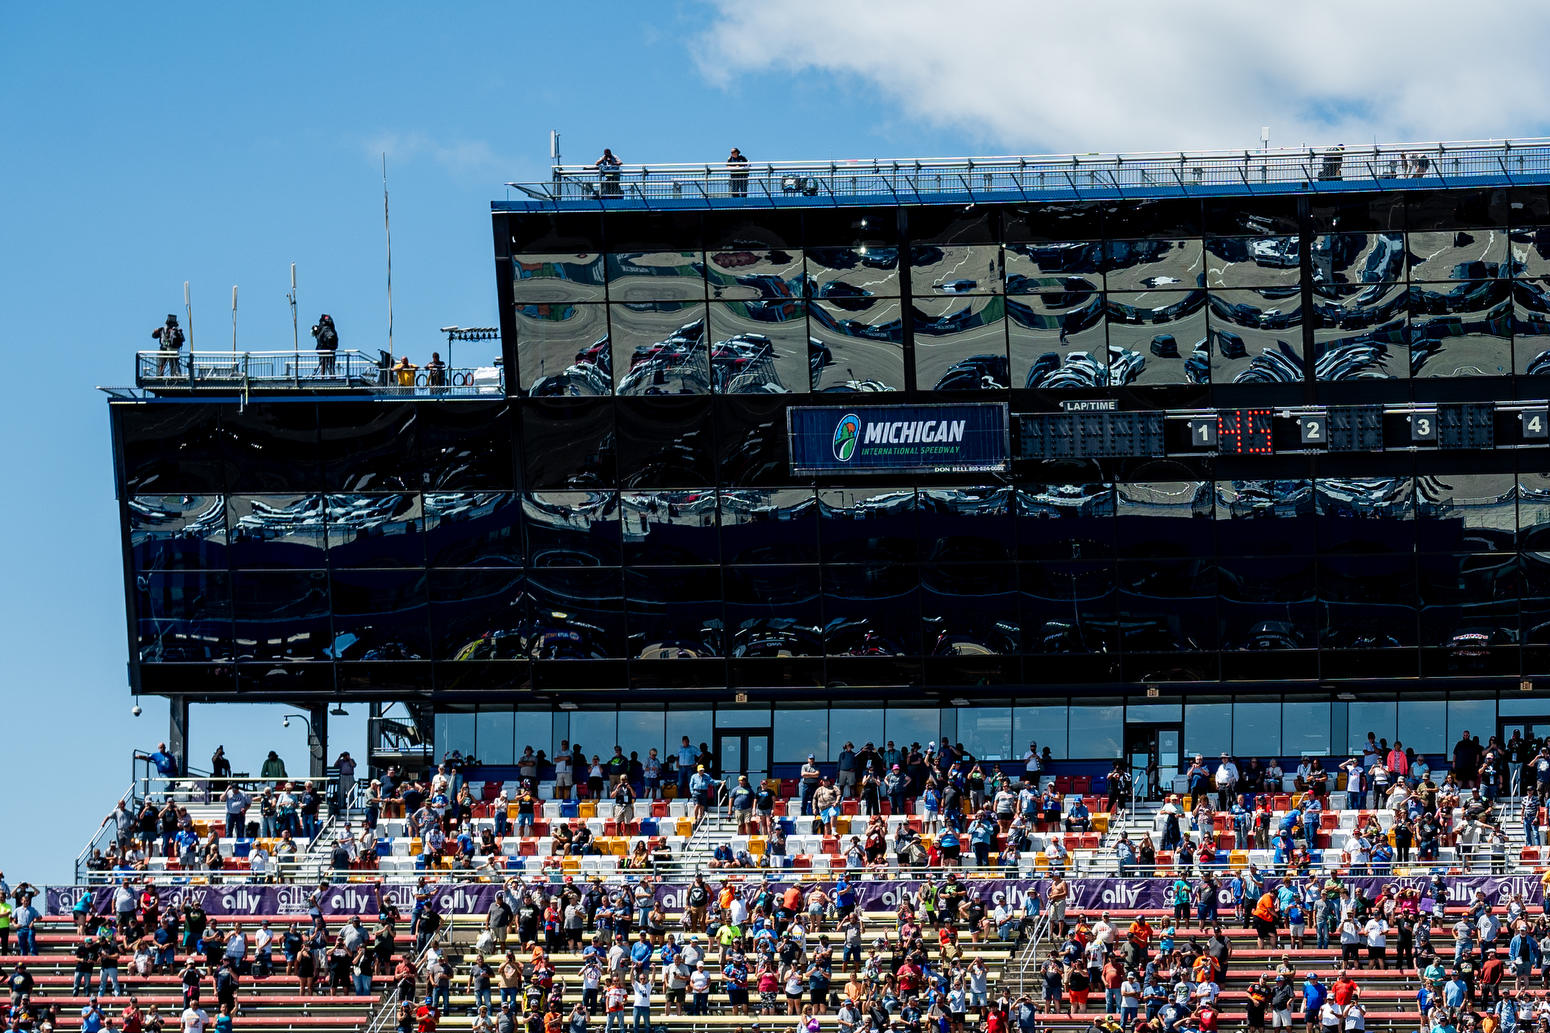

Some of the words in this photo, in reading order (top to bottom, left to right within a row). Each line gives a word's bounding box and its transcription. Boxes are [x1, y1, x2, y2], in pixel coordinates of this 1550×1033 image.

[1067, 401, 1115, 411] LAP/TIME
[864, 420, 966, 444] MICHIGAN
[1198, 424, 1209, 440] 1
[1218, 410, 1271, 453] 45
[1307, 421, 1320, 438] 2
[1417, 418, 1430, 435] 3
[1528, 415, 1542, 432] 4
[861, 446, 919, 456] INTERNATIONAL
[920, 446, 961, 454] SPEEDWAY
[662, 889, 688, 908] all
[1102, 885, 1140, 907] ally
[1498, 877, 1538, 901] ally
[222, 890, 261, 914] ally
[331, 890, 369, 912] ally
[440, 890, 478, 912] ally
